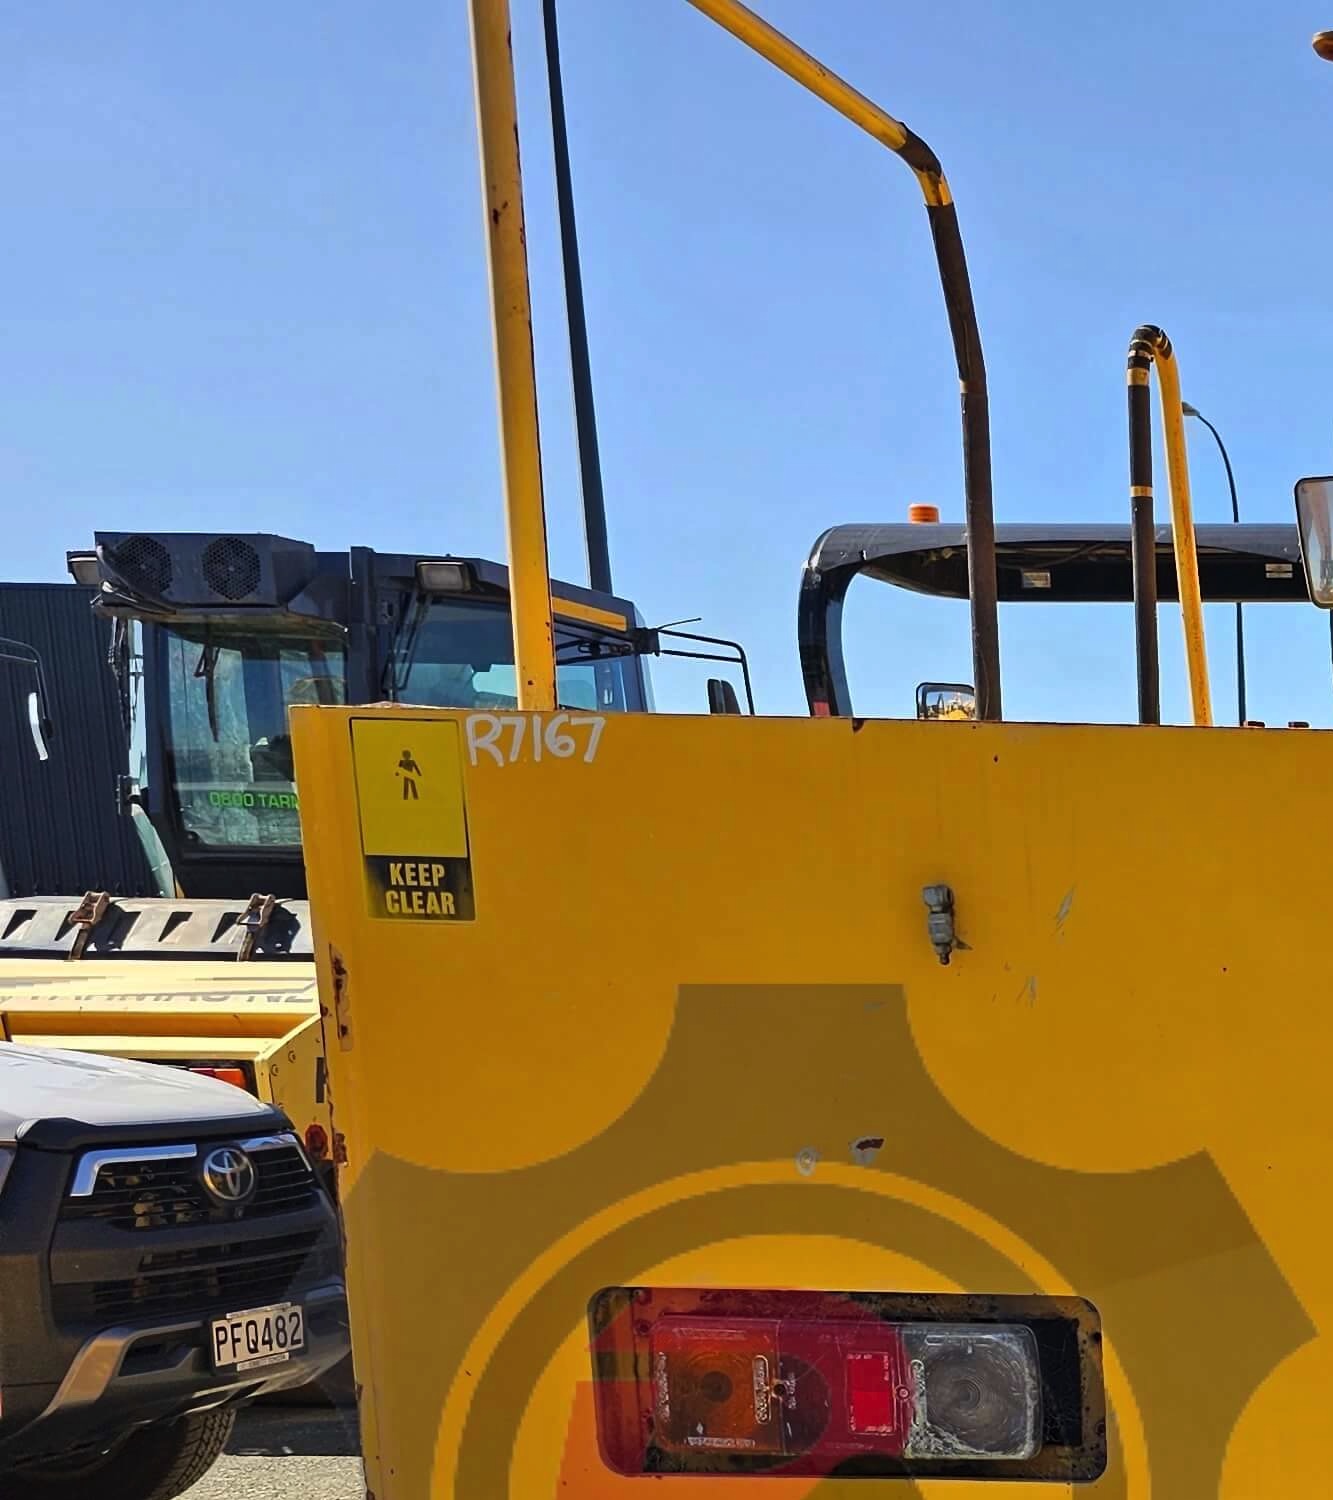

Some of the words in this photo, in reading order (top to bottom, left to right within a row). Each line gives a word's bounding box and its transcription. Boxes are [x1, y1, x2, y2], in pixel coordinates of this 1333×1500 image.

[466, 713, 606, 767] R7167
[209, 791, 254, 808] 0800
[389, 863, 445, 887] KEEP
[385, 890, 456, 915] CLEAR
[215, 1312, 302, 1362] PFQ482
